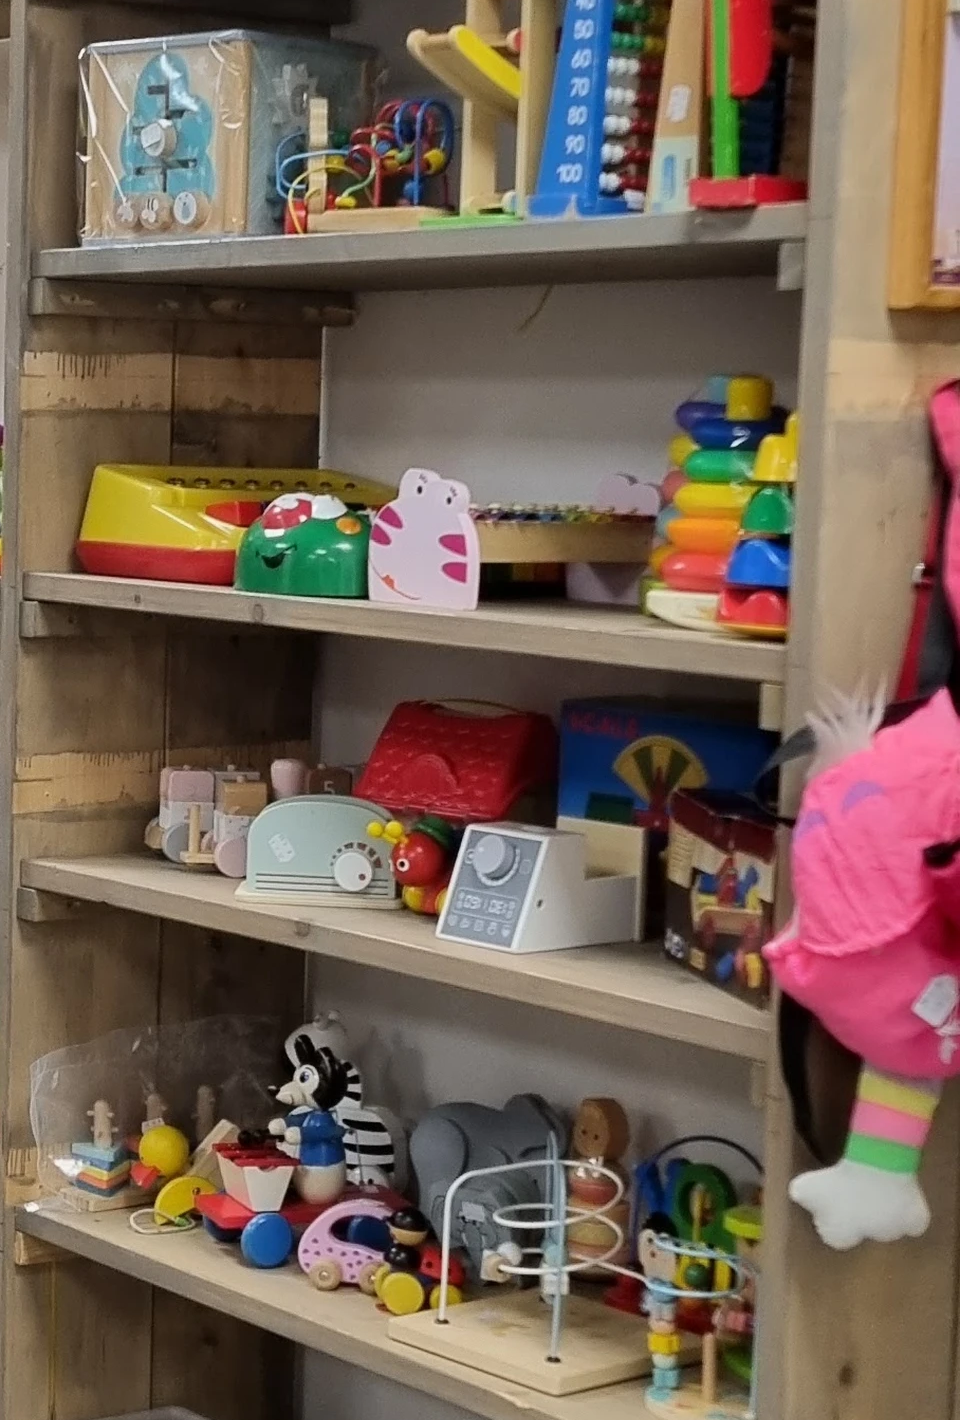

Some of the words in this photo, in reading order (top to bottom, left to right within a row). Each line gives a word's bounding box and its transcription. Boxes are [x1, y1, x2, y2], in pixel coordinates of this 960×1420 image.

[573, 18, 595, 40] 50
[571, 48, 592, 69] 60
[570, 77, 591, 97] 70
[567, 105, 588, 126] 80
[565, 134, 586, 155] 90
[556, 163, 583, 183] 100
[323, 780, 335, 795] 5
